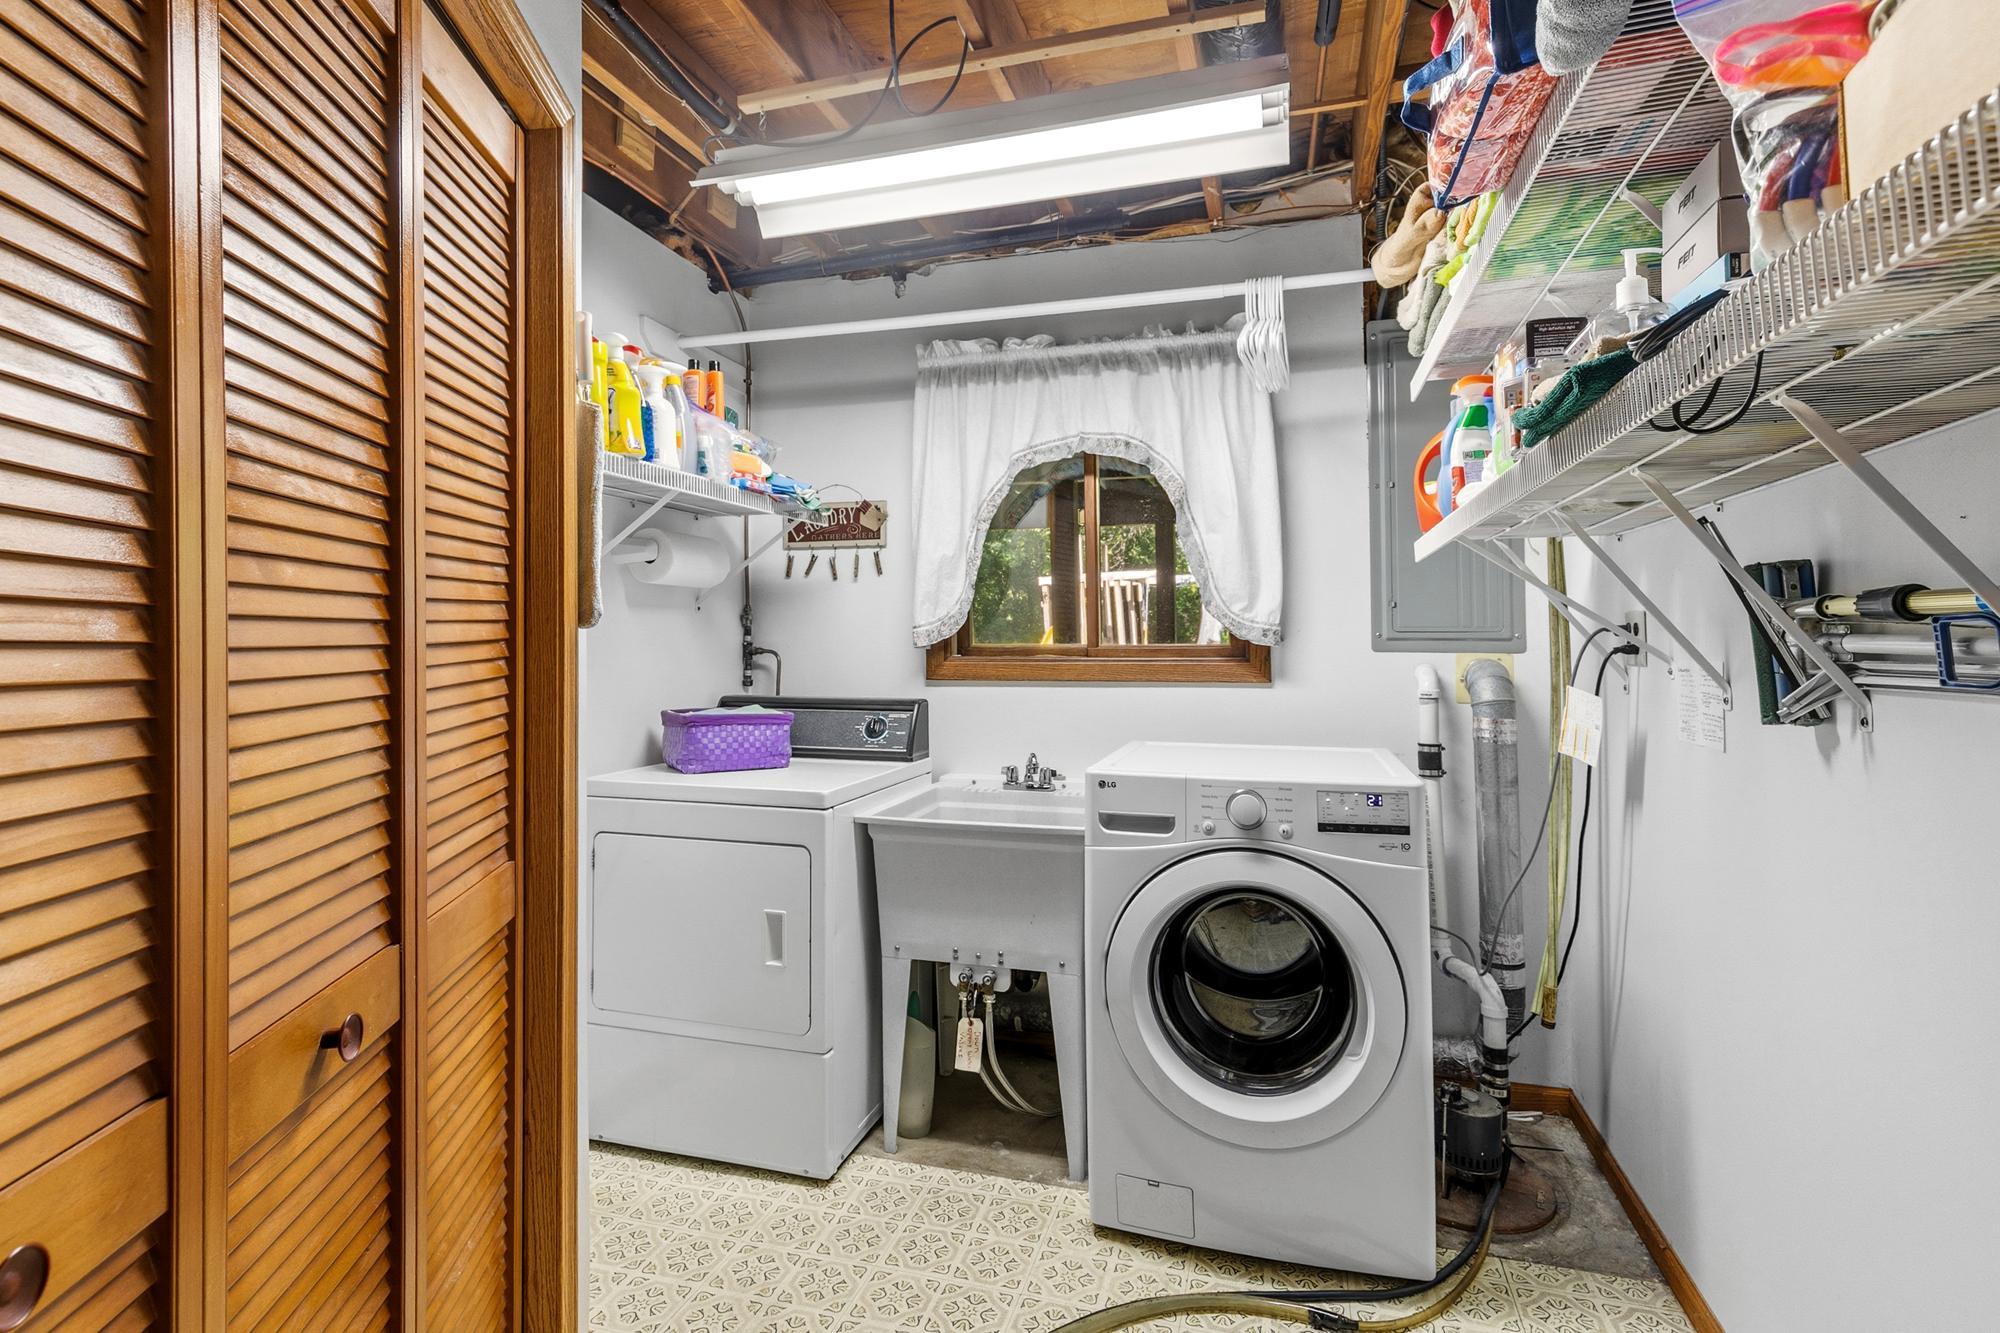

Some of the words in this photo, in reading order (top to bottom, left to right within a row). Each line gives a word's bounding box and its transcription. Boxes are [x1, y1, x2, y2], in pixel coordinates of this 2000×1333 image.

[1677, 185, 1697, 214] FEIT
[1677, 243, 1697, 271] FEIT
[791, 506, 856, 542] LAUDRY
[855, 531, 880, 539] HERE
